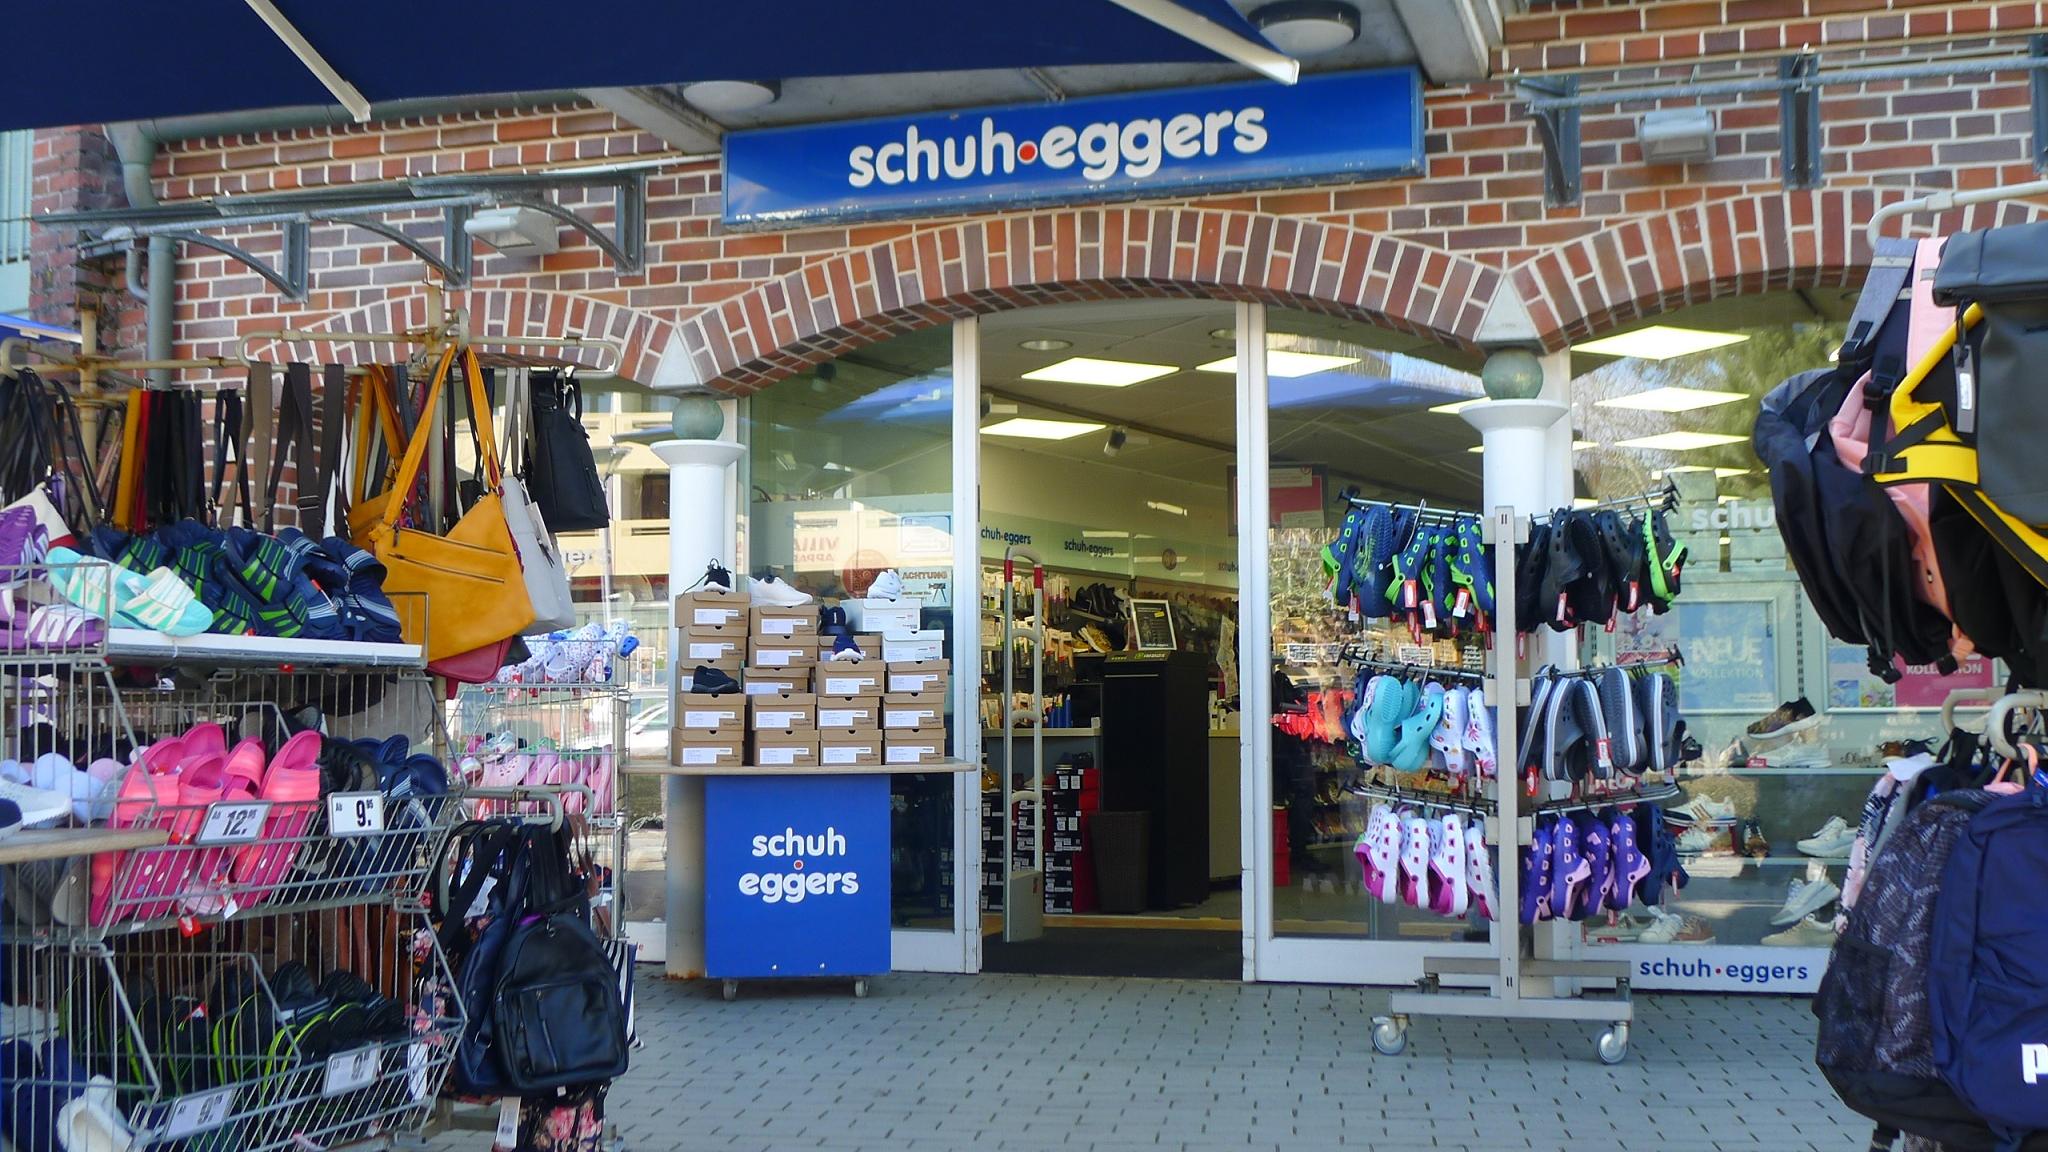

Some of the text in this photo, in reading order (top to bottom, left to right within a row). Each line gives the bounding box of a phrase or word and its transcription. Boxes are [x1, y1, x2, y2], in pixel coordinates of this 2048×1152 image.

[902, 570, 948, 581] ACHTUNG
[751, 826, 846, 857] schuh
[738, 872, 859, 904] eggers
